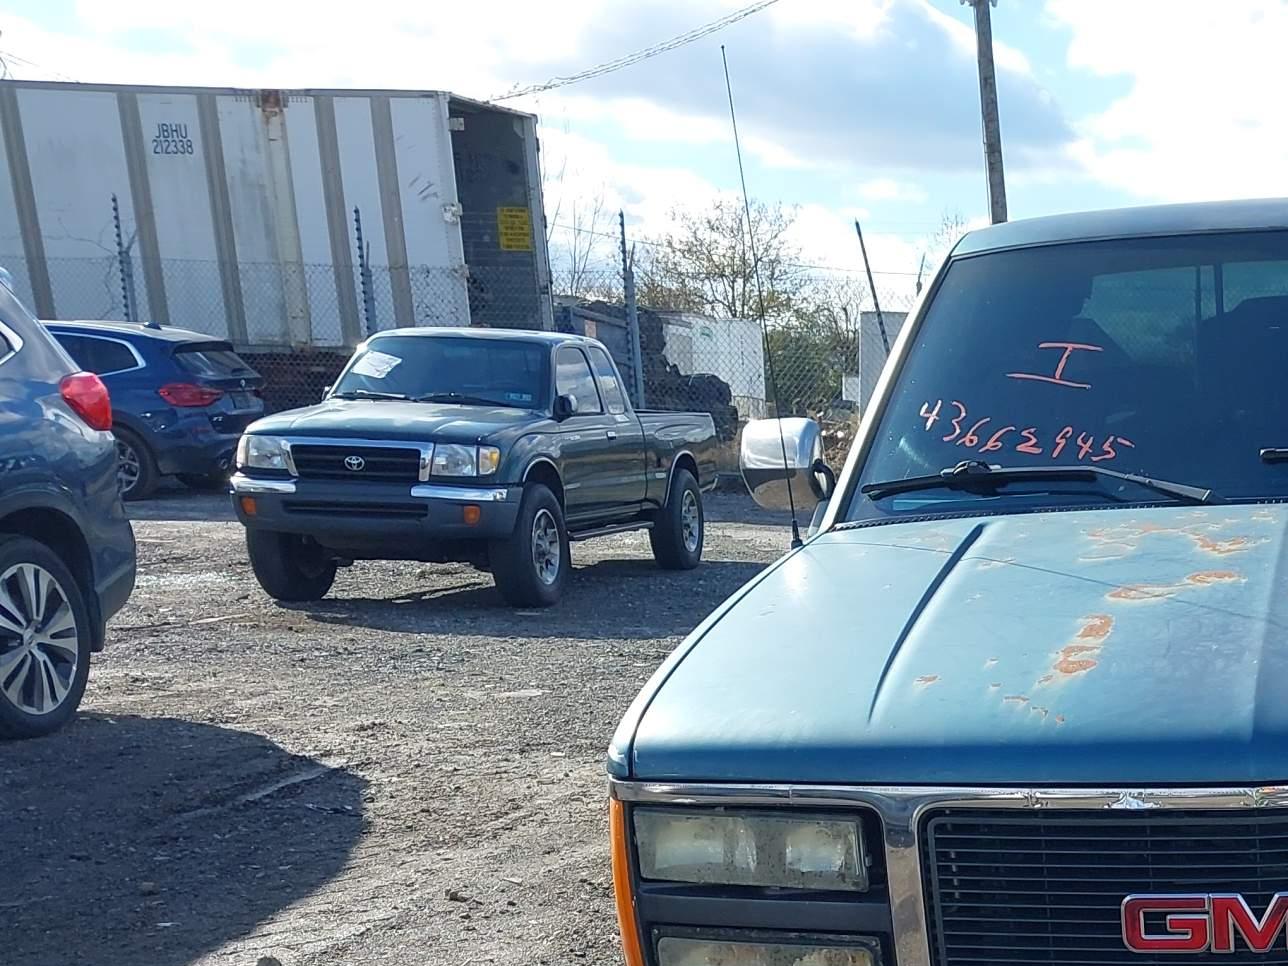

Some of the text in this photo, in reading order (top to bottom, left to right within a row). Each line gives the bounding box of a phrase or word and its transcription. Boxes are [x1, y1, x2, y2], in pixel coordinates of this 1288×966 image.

[155, 123, 188, 139] JBHU
[152, 139, 194, 155] 212338
[919, 400, 1135, 462] 43662945
